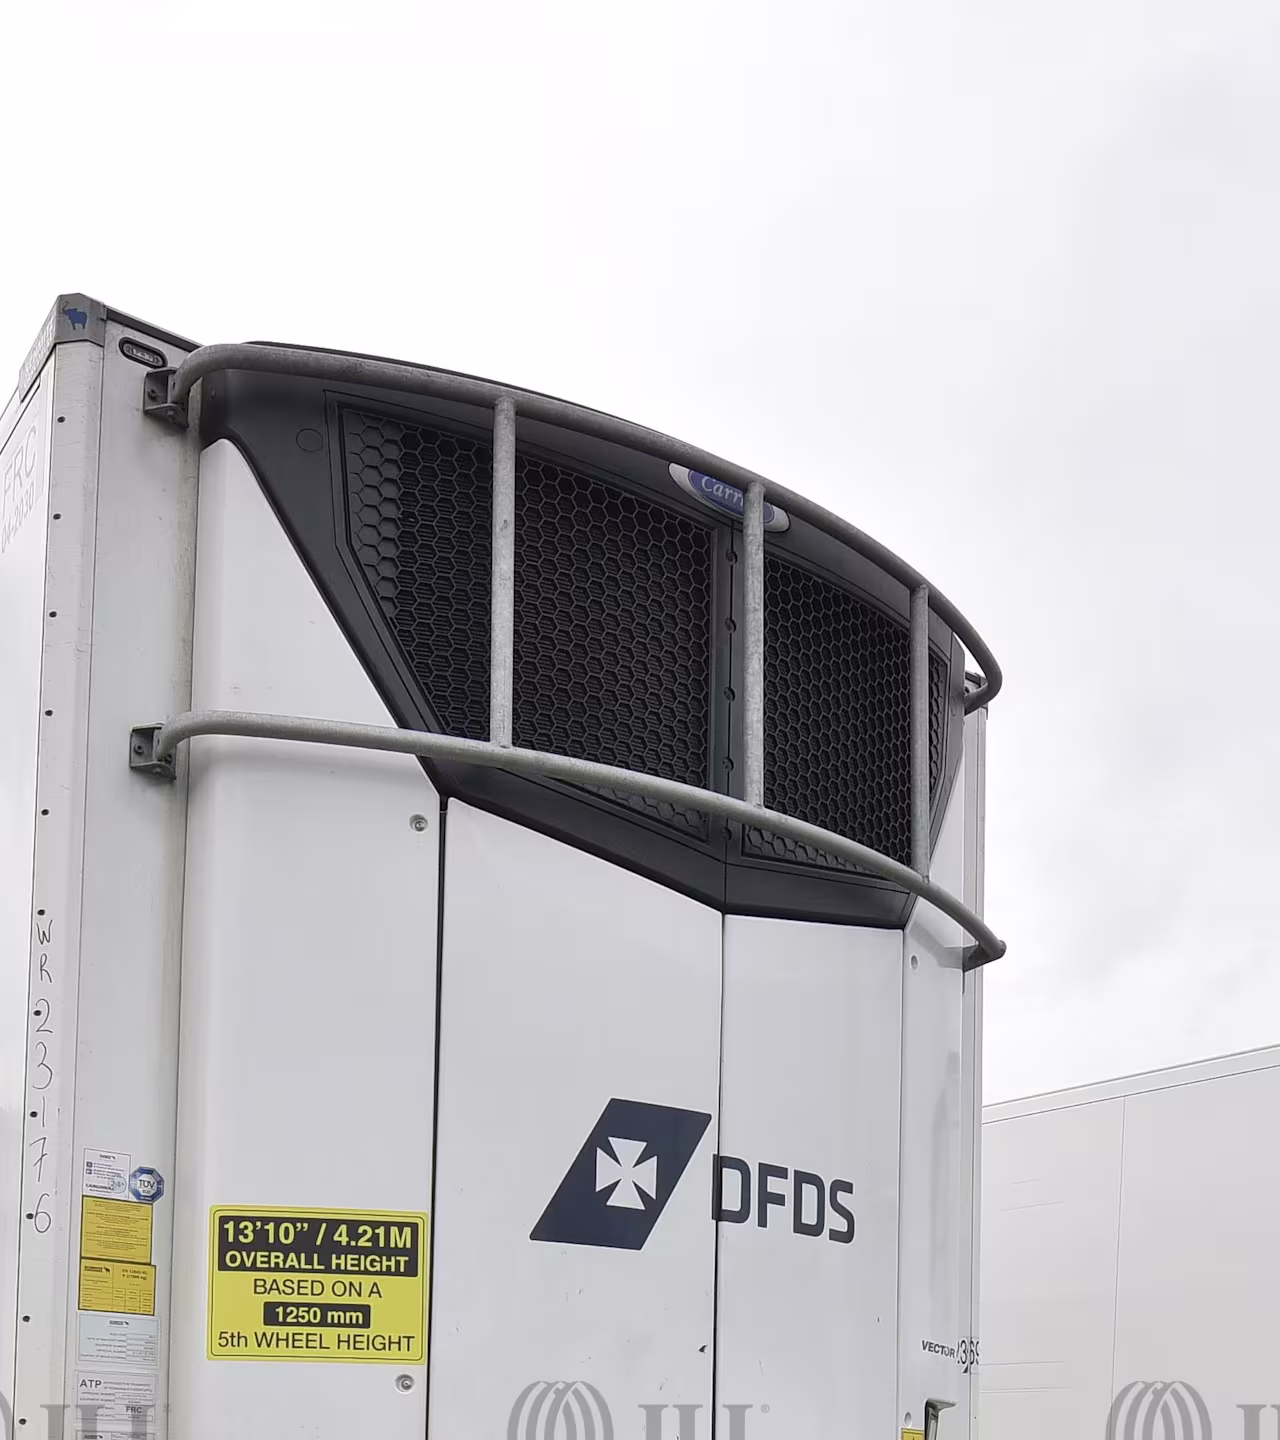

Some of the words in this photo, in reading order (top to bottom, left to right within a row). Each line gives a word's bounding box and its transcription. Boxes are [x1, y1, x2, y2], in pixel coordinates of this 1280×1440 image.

[701, 475, 744, 507] Carri
[711, 1153, 856, 1244] DFDS
[315, 1222, 327, 1246] /
[333, 1223, 412, 1249] 4.21M
[225, 1250, 325, 1270] OVERALL
[331, 1253, 409, 1273] HEIGHT
[253, 1278, 325, 1297] BASED
[331, 1280, 362, 1298] ON
[368, 1282, 383, 1298] A
[275, 1306, 322, 1324] 1250
[326, 1310, 363, 1325] mm
[218, 1331, 248, 1348] 5th
[253, 1332, 331, 1350] WHEEL
[337, 1334, 415, 1352] HEIGHT
[921, 1339, 956, 1359] VECTOR
[79, 1379, 102, 1389] ATP
